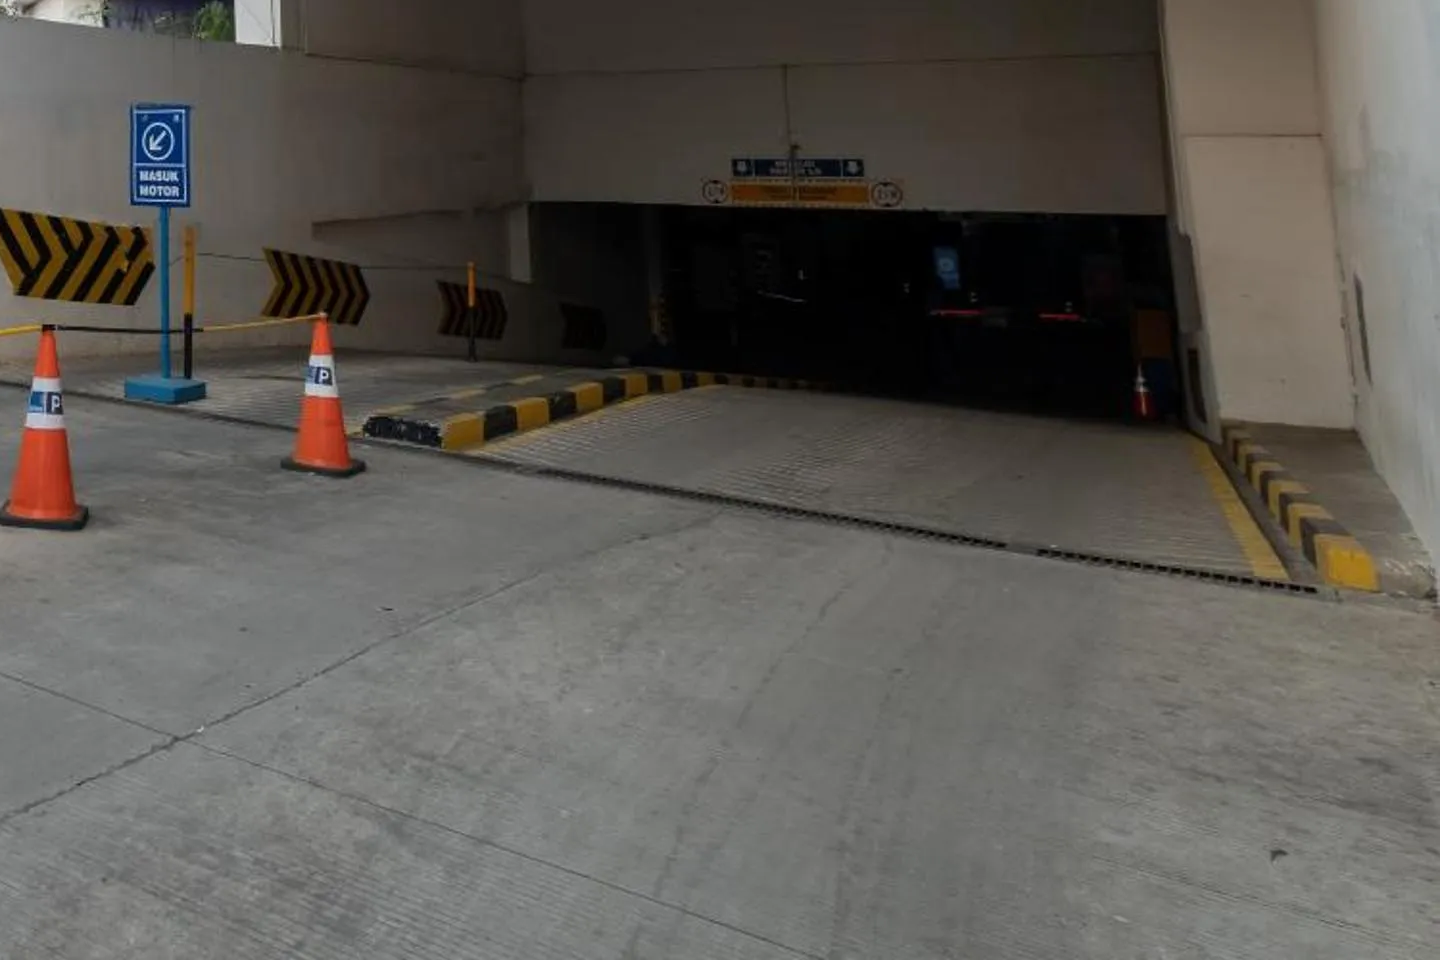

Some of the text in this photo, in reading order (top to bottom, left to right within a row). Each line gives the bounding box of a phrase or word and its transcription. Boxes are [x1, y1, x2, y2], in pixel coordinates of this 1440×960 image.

[139, 170, 180, 182] MASUK
[139, 184, 180, 197] MOTOR
[318, 368, 329, 384] P
[51, 394, 61, 413] P
